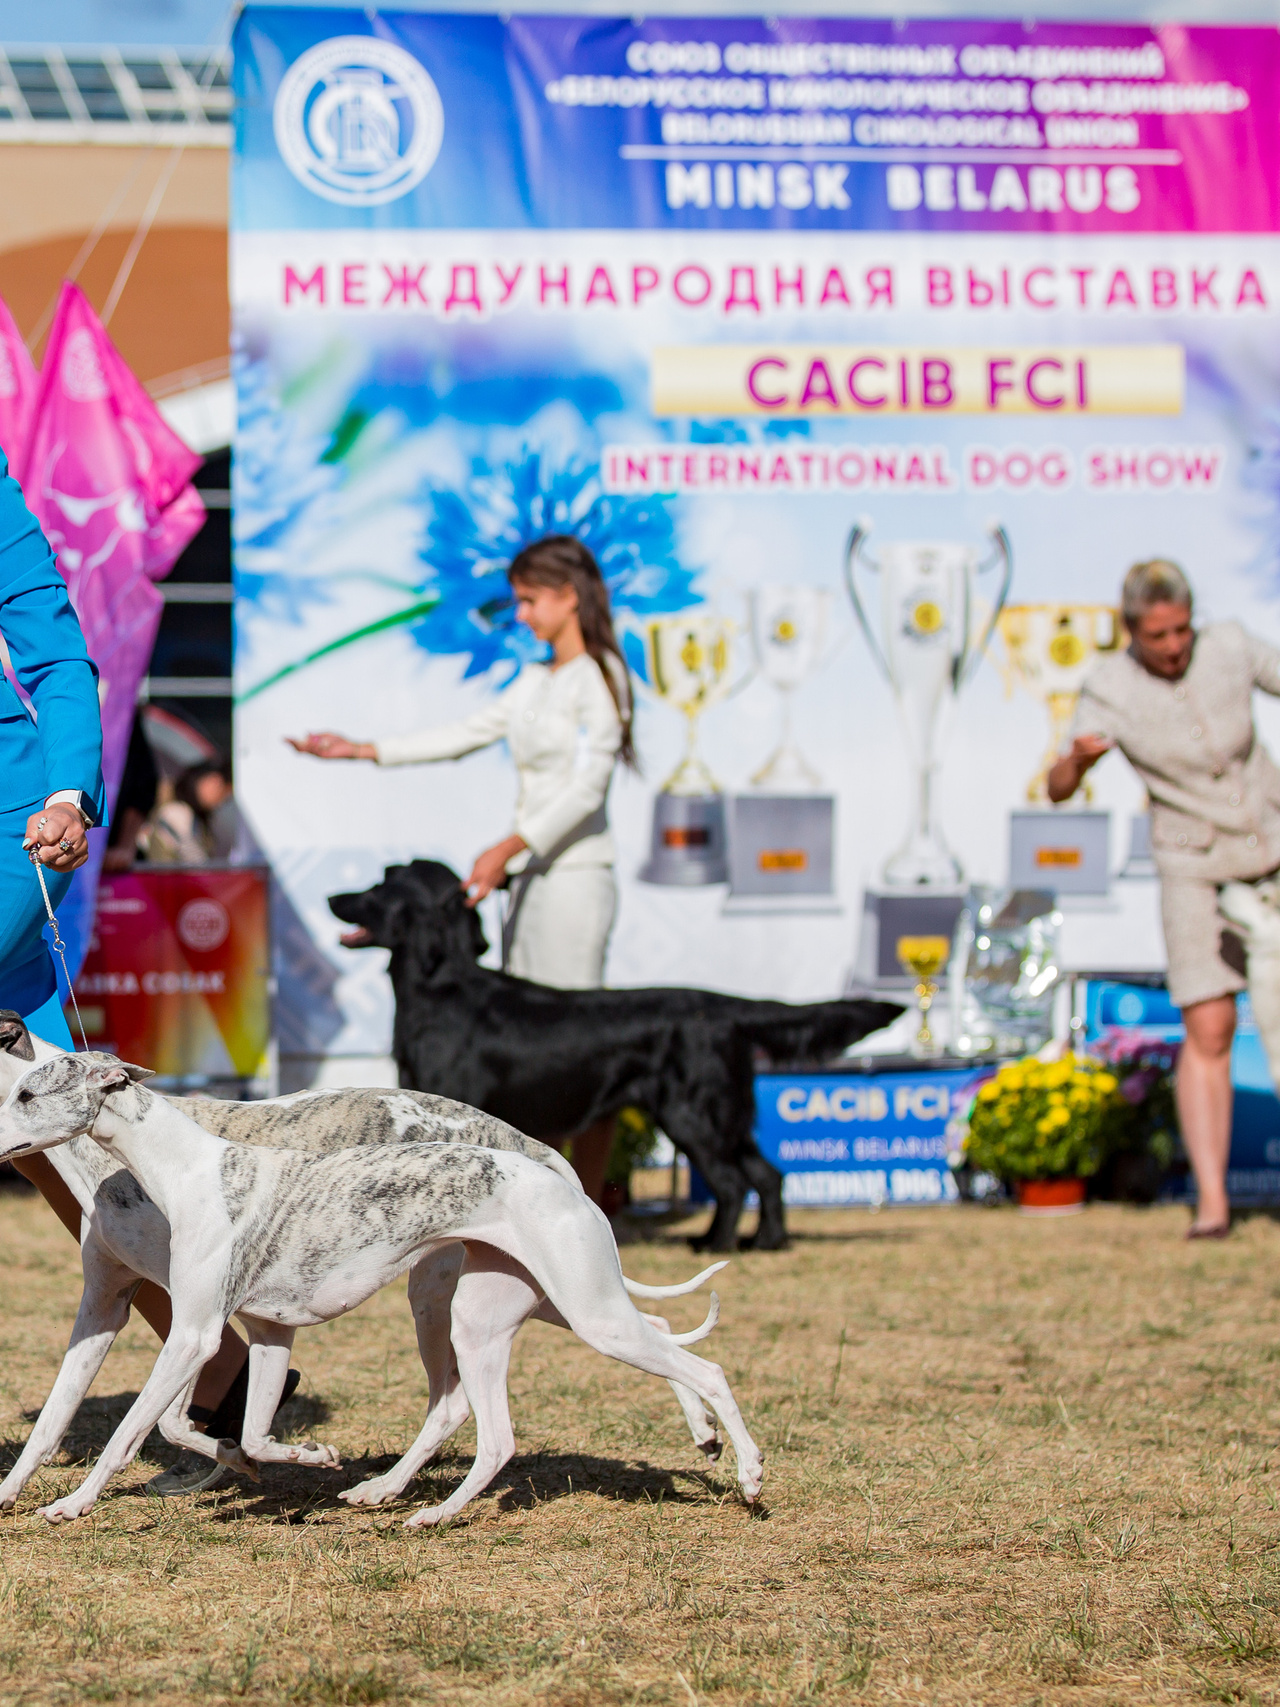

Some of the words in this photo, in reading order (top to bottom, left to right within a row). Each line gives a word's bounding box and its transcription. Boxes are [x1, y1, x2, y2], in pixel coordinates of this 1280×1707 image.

[665, 162, 851, 210] MINSK
[886, 164, 1141, 214] BELARUS
[283, 263, 894, 314] МЕЖДУНАРОДНАЯ
[926, 266, 1267, 309] ВЫСТАВКА
[747, 356, 956, 411] CACIB
[986, 358, 1090, 411] FCI
[608, 452, 950, 488] INTERNATIONAL
[971, 453, 1067, 488] DOG
[1089, 454, 1219, 488] SHOW
[777, 1087, 888, 1123] CACIB
[894, 1085, 950, 1121] FCI
